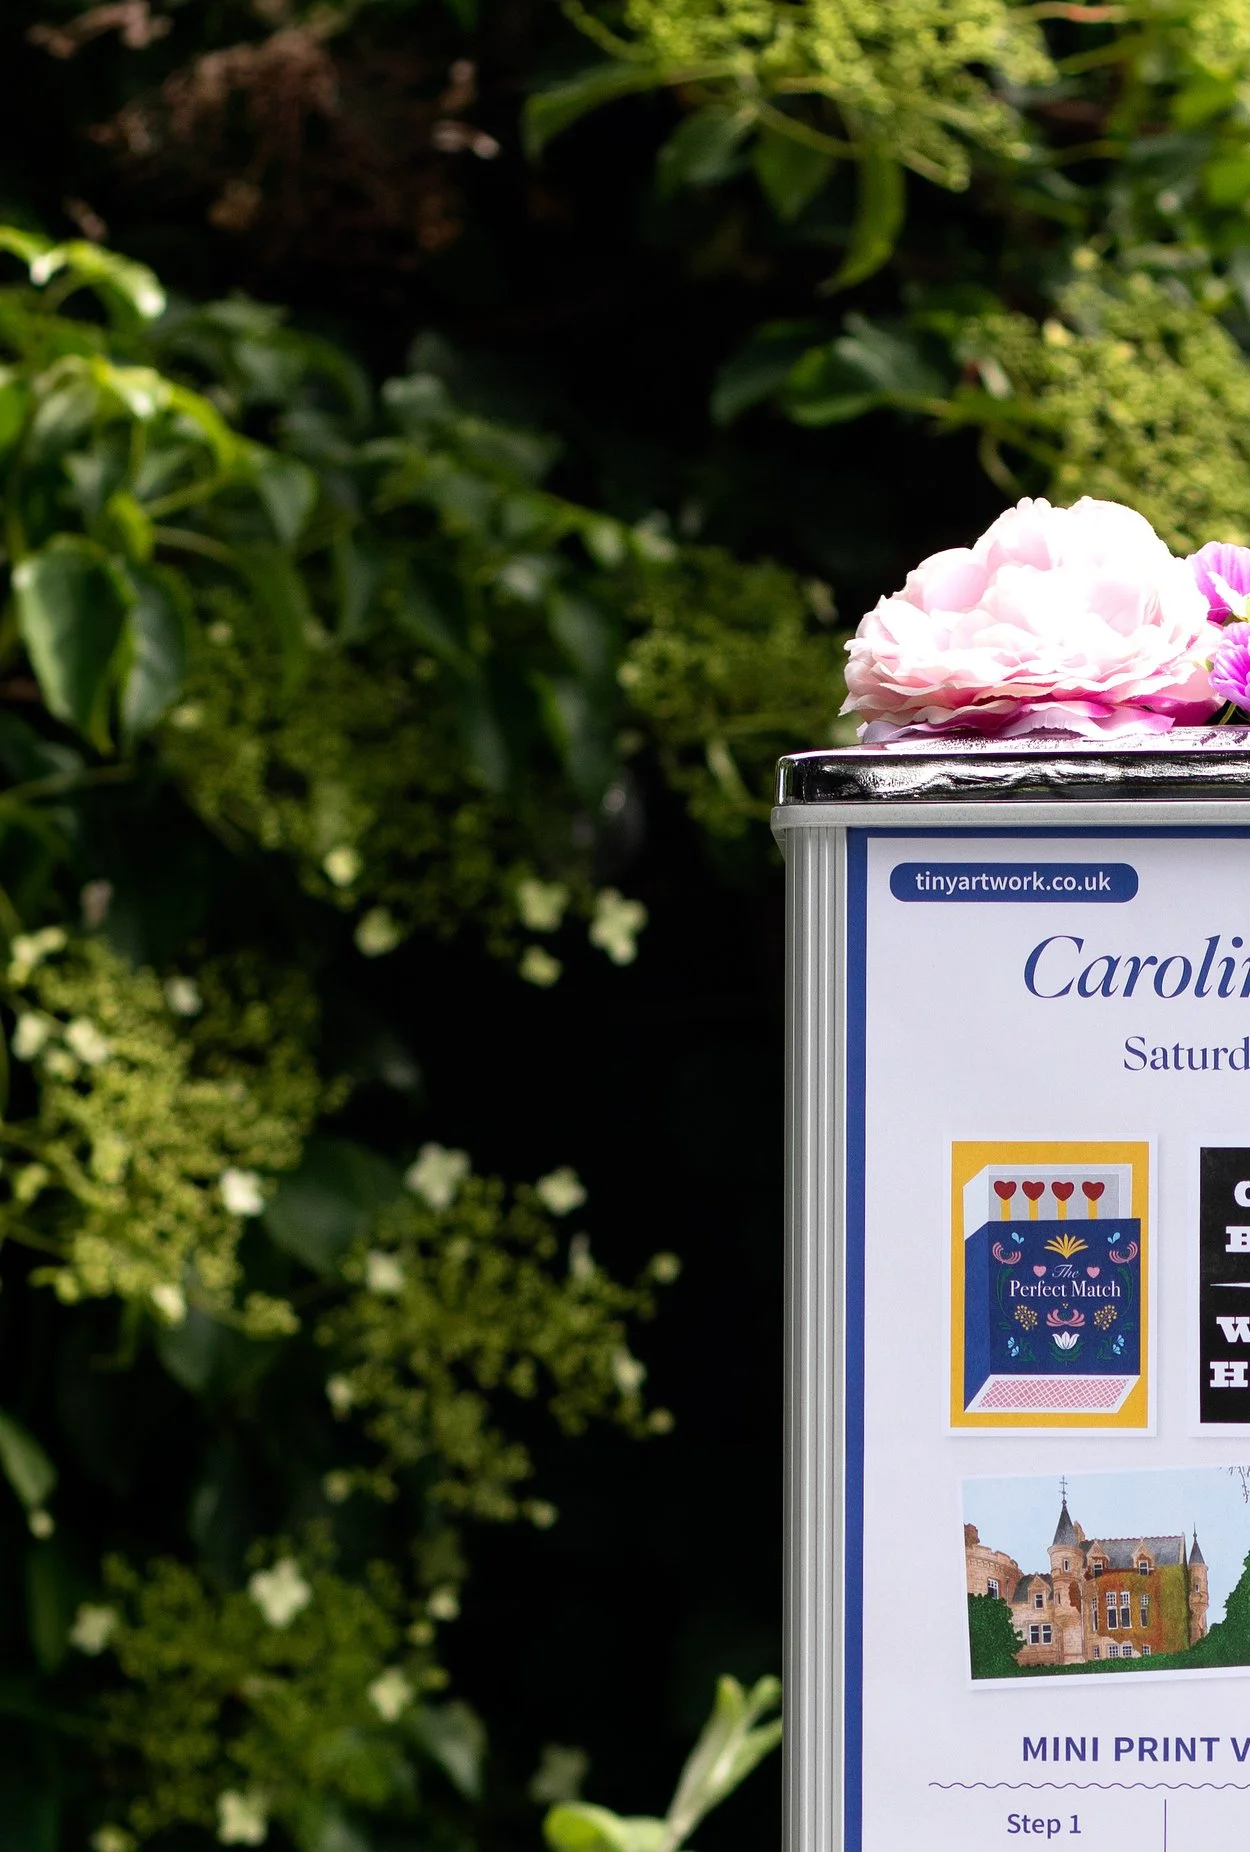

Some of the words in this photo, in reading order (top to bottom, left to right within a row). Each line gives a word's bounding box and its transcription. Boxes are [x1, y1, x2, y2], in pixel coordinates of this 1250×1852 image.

[915, 870, 1111, 896] tinyartwork.co.uk
[1051, 1264, 1079, 1279] The
[1010, 1279, 1067, 1298] Perfect
[1071, 1280, 1121, 1298] Match
[1022, 1736, 1099, 1762] MINI
[1114, 1736, 1218, 1762] PRINT
[1007, 1813, 1062, 1840] Step
[1069, 1814, 1082, 1834] 1
